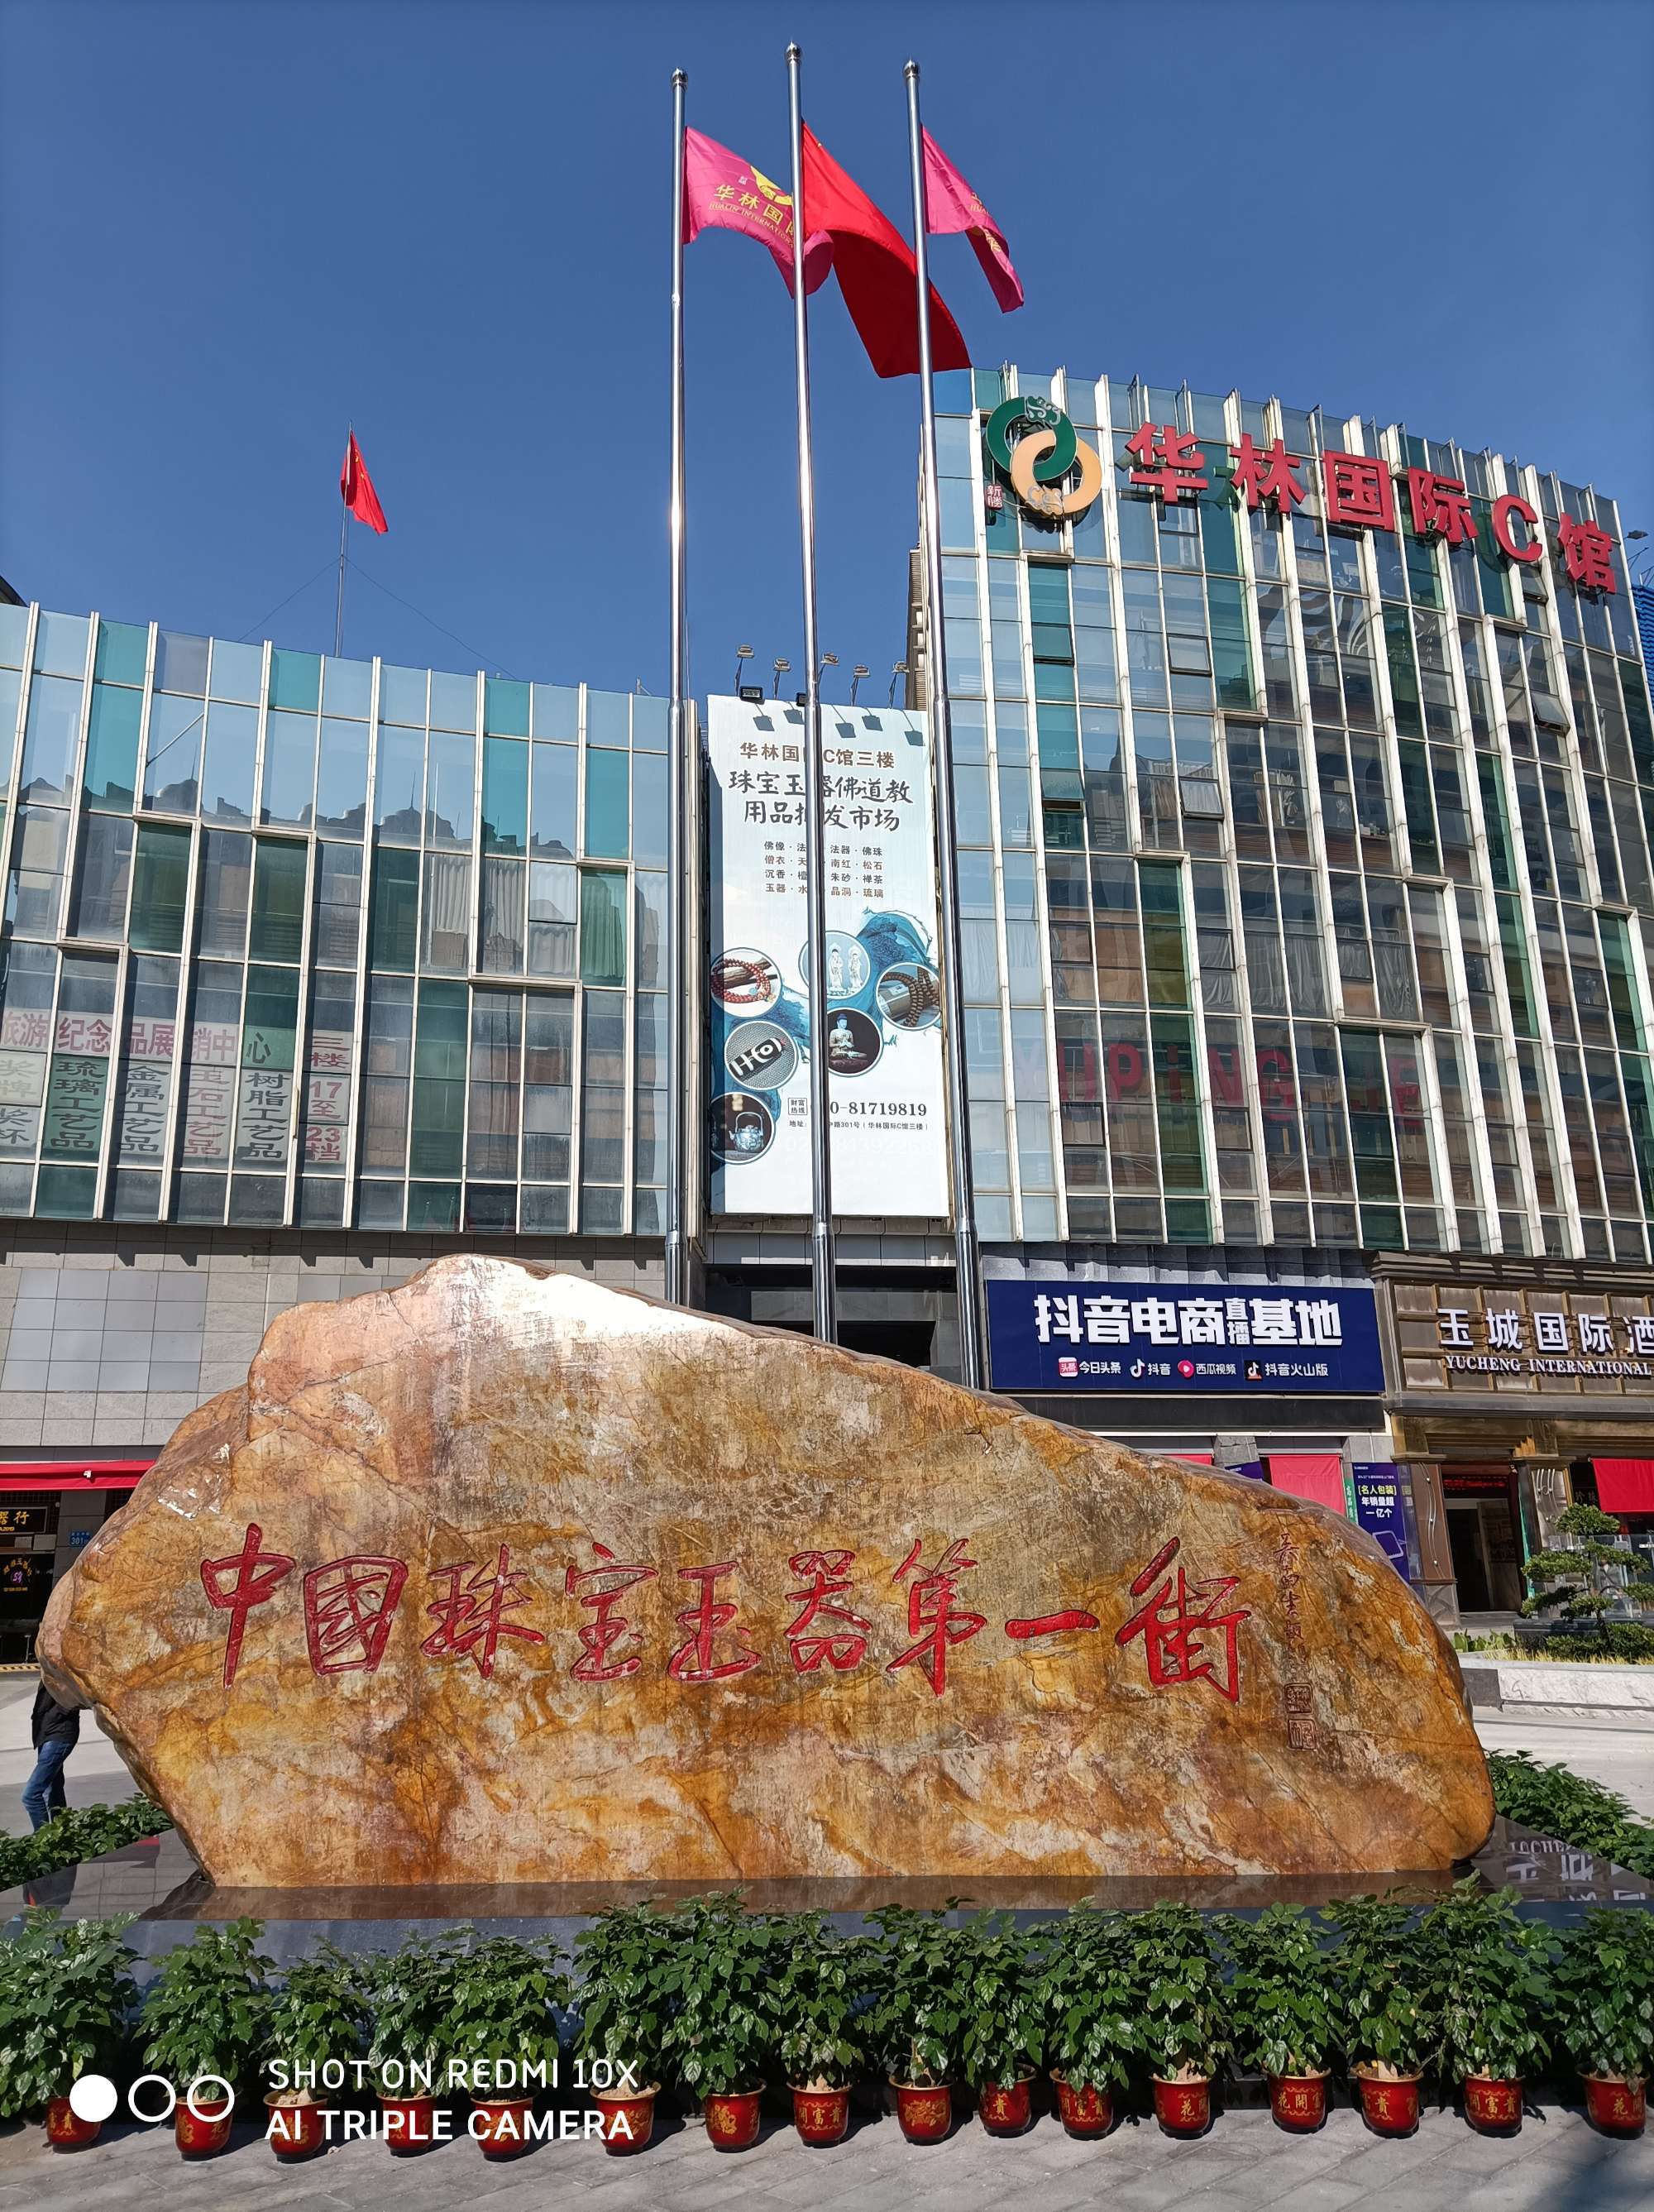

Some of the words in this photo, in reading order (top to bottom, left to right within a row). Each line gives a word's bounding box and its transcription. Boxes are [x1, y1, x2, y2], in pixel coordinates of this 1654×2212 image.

[1126, 421, 1617, 594] 华林国际C馆
[740, 742, 895, 768] 华林国C馆三楼
[829, 1101, 927, 1116] 0-81719819
[1079, 1361, 1121, 1375] 今日头条
[1148, 1362, 1171, 1377] 抖音
[1196, 1362, 1236, 1376] 西瓜视频
[1264, 1362, 1329, 1377] 抖音火山版
[1445, 1355, 1522, 1372] YUCHENG
[1529, 1358, 1652, 1376] INTERNATIONAL
